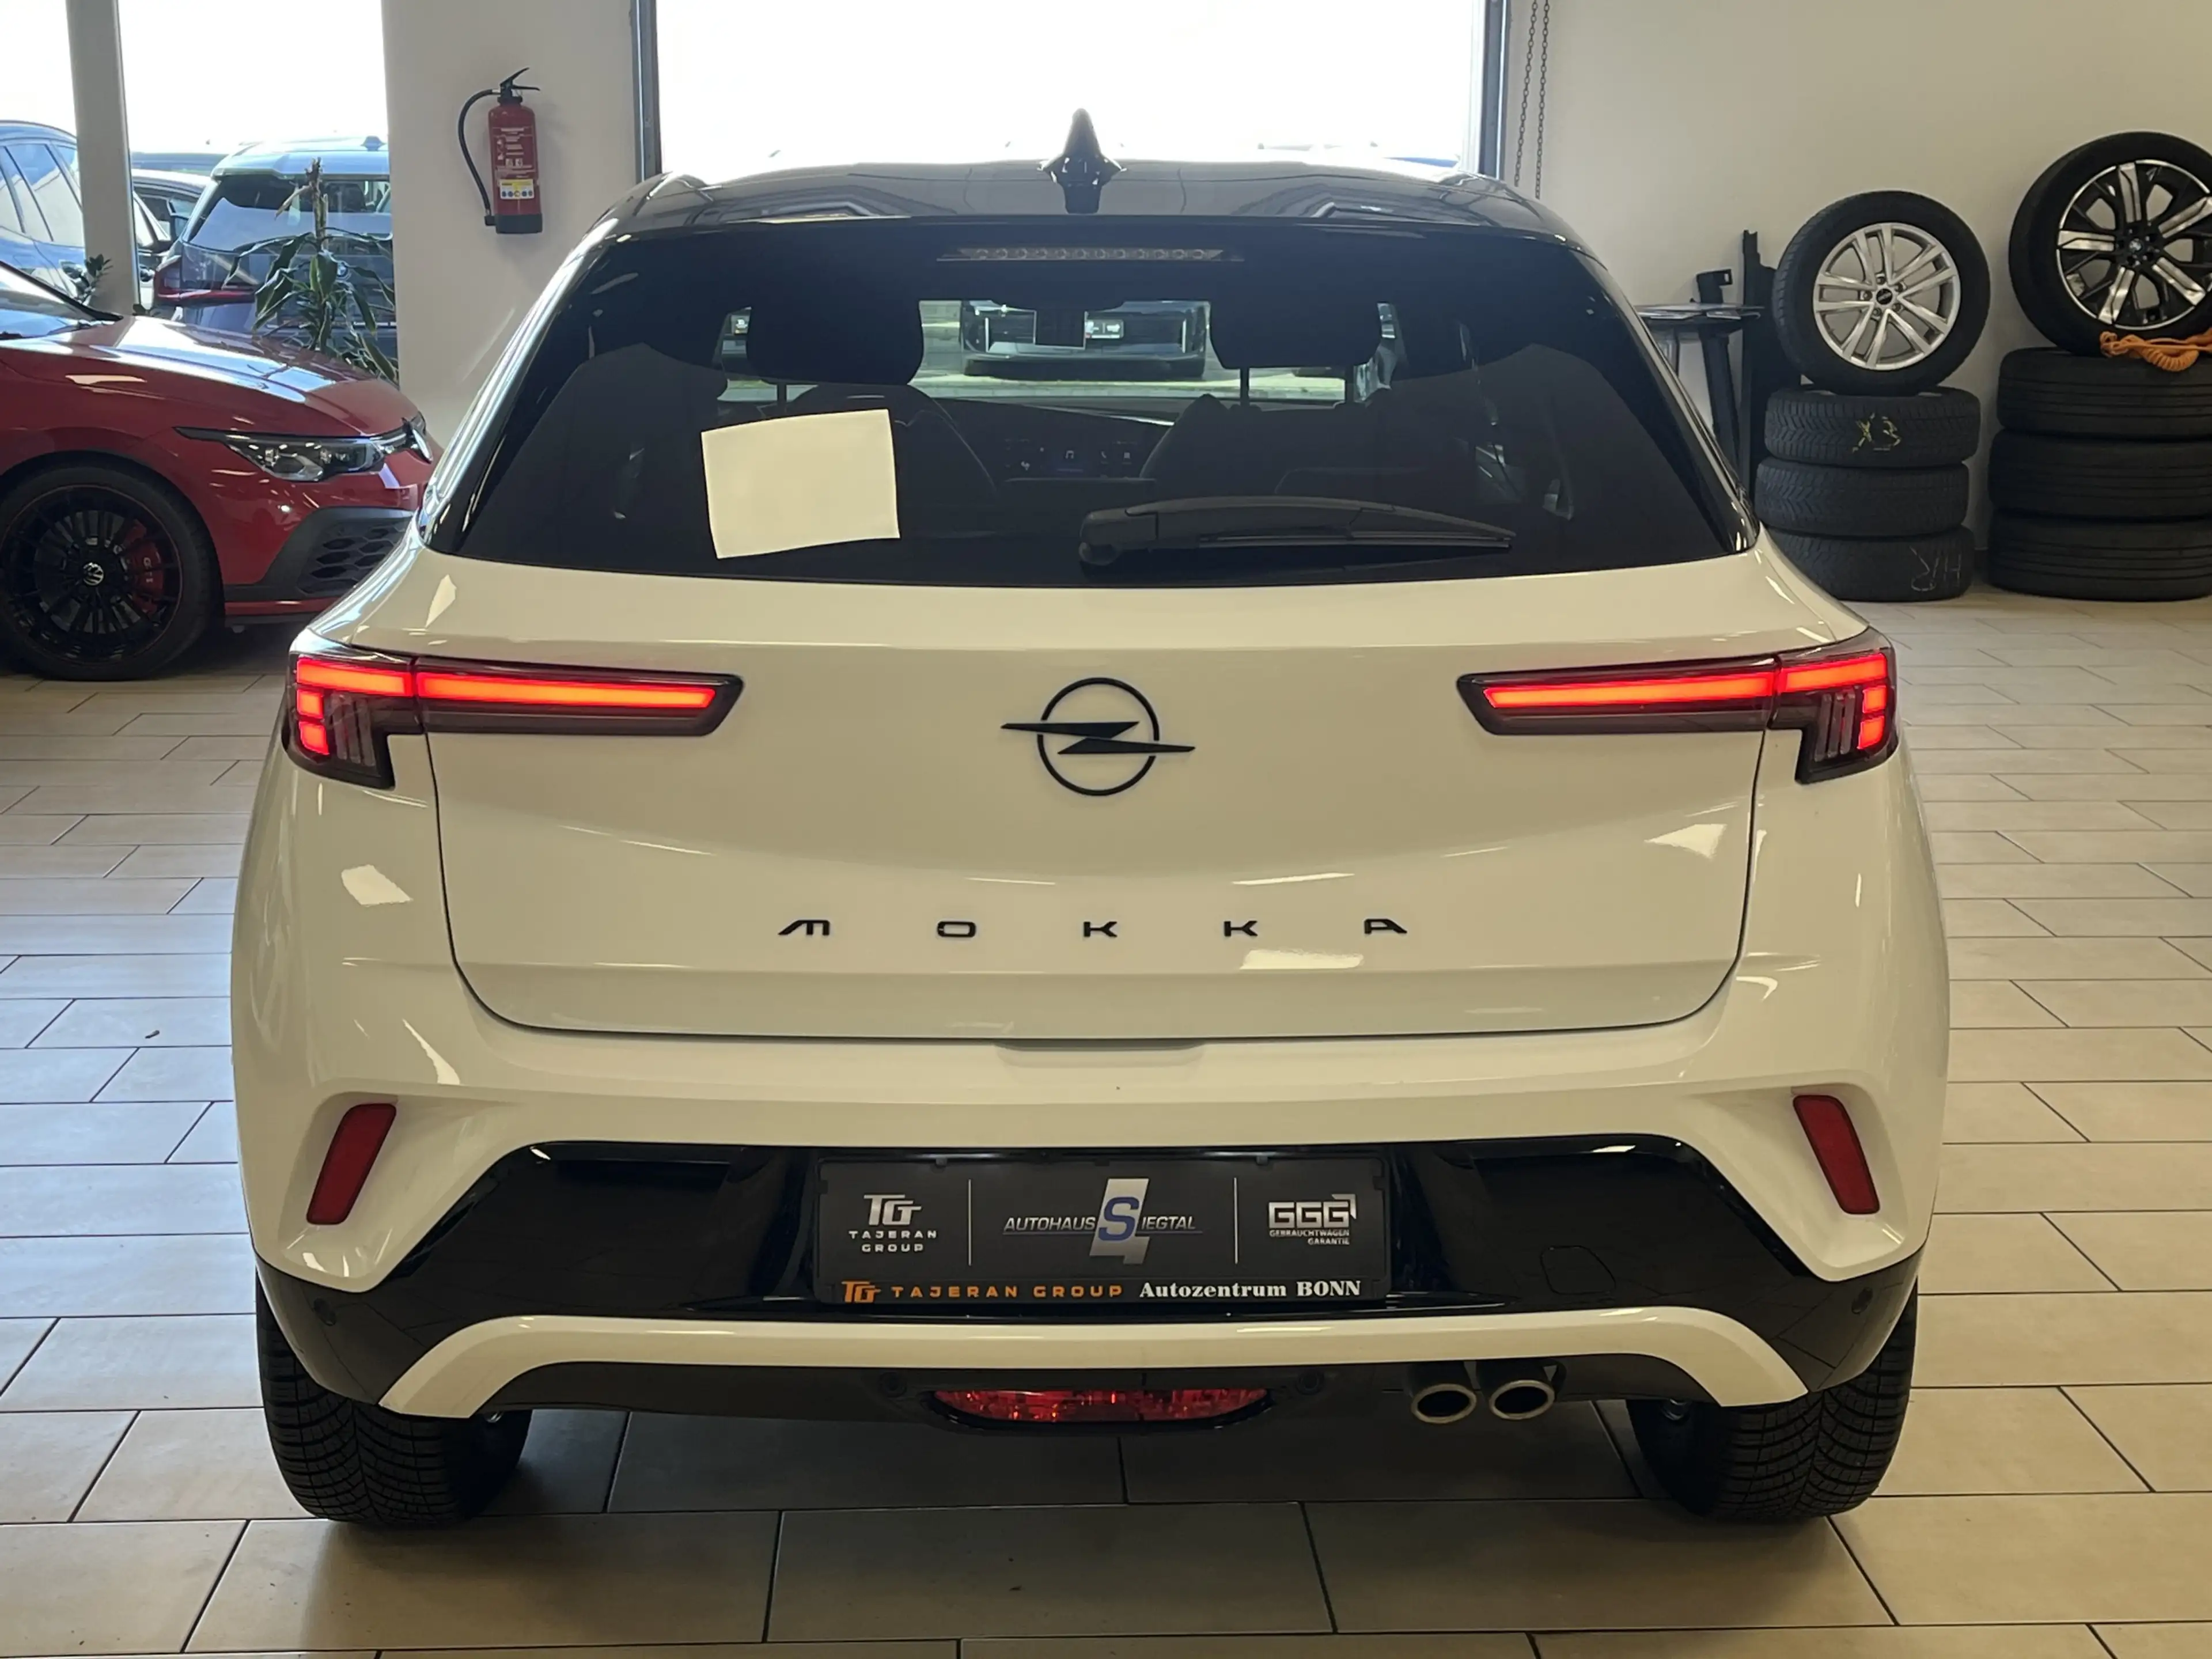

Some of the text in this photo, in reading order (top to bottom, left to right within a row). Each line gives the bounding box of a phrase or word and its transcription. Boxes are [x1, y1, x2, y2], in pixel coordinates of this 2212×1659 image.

[778, 918, 1408, 938] MOKKA
[1268, 1200, 1350, 1229] GGG
[1003, 1216, 1096, 1232] AUTOHAUS
[848, 1230, 937, 1239] TAJERAN
[1269, 1229, 1350, 1237] GEBRAUCHTWAGEN
[1307, 1237, 1350, 1245] GARANTIE
[861, 1243, 924, 1253] GROUP
[891, 1286, 1018, 1298] TAJERAN
[1033, 1285, 1123, 1298] GROUP
[1139, 1282, 1287, 1298] Autozentrum
[1296, 1280, 1361, 1297] BONN
